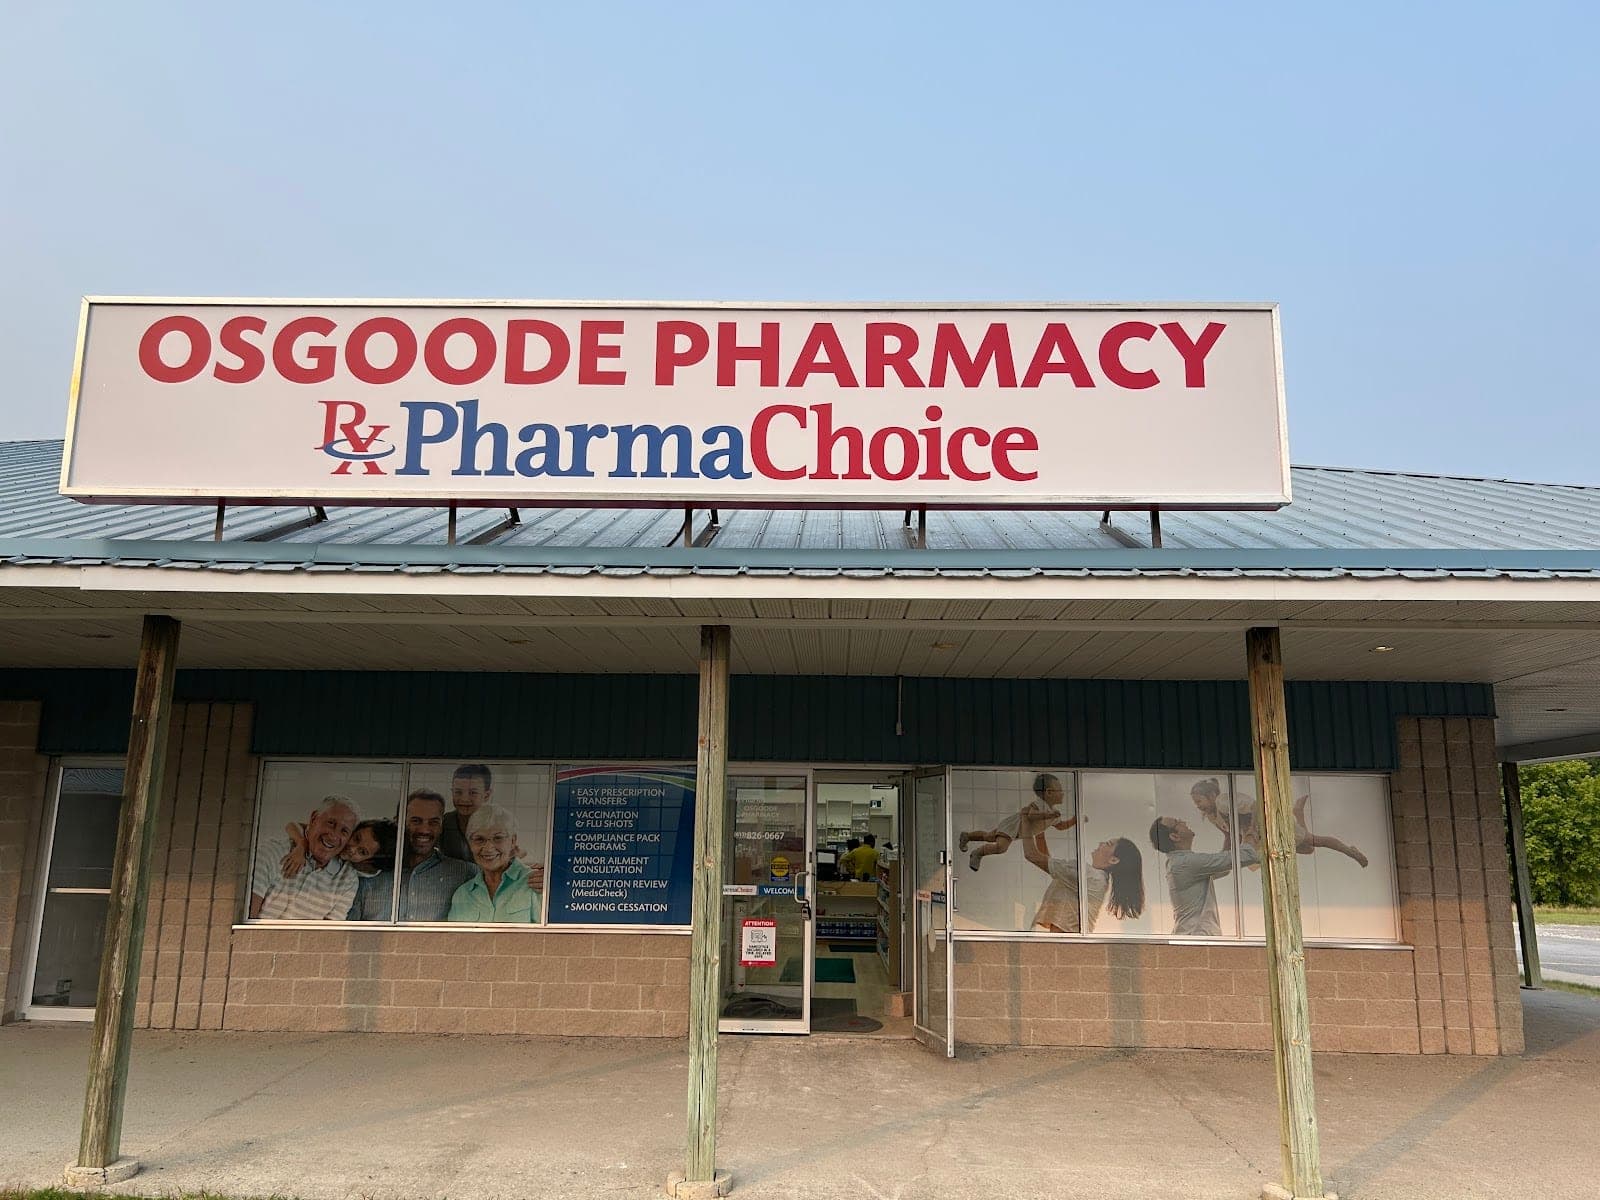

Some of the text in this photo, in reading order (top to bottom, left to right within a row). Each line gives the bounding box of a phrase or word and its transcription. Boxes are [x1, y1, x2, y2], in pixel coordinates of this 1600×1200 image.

[138, 315, 1227, 390] OSGOODE PHARMACY
[395, 400, 1039, 481] PharmaChoice
[577, 788, 666, 797] EASY PRESCRIPTION
[577, 797, 628, 805] TRANSFERS
[576, 811, 639, 819] VACCINATION
[575, 819, 634, 828] & FLU SHOTS
[574, 833, 660, 842] COMPLIANCE PACK
[574, 842, 627, 851] PROGRAMS
[573, 857, 649, 865] MINOR AILMENT
[572, 865, 643, 874] CONSULTATION
[571, 880, 668, 889] MEDICATION REVIEW
[571, 889, 628, 899] (MedsCheck)
[763, 887, 798, 895] WELCOM
[570, 903, 668, 912] SMOKING CESSATION
